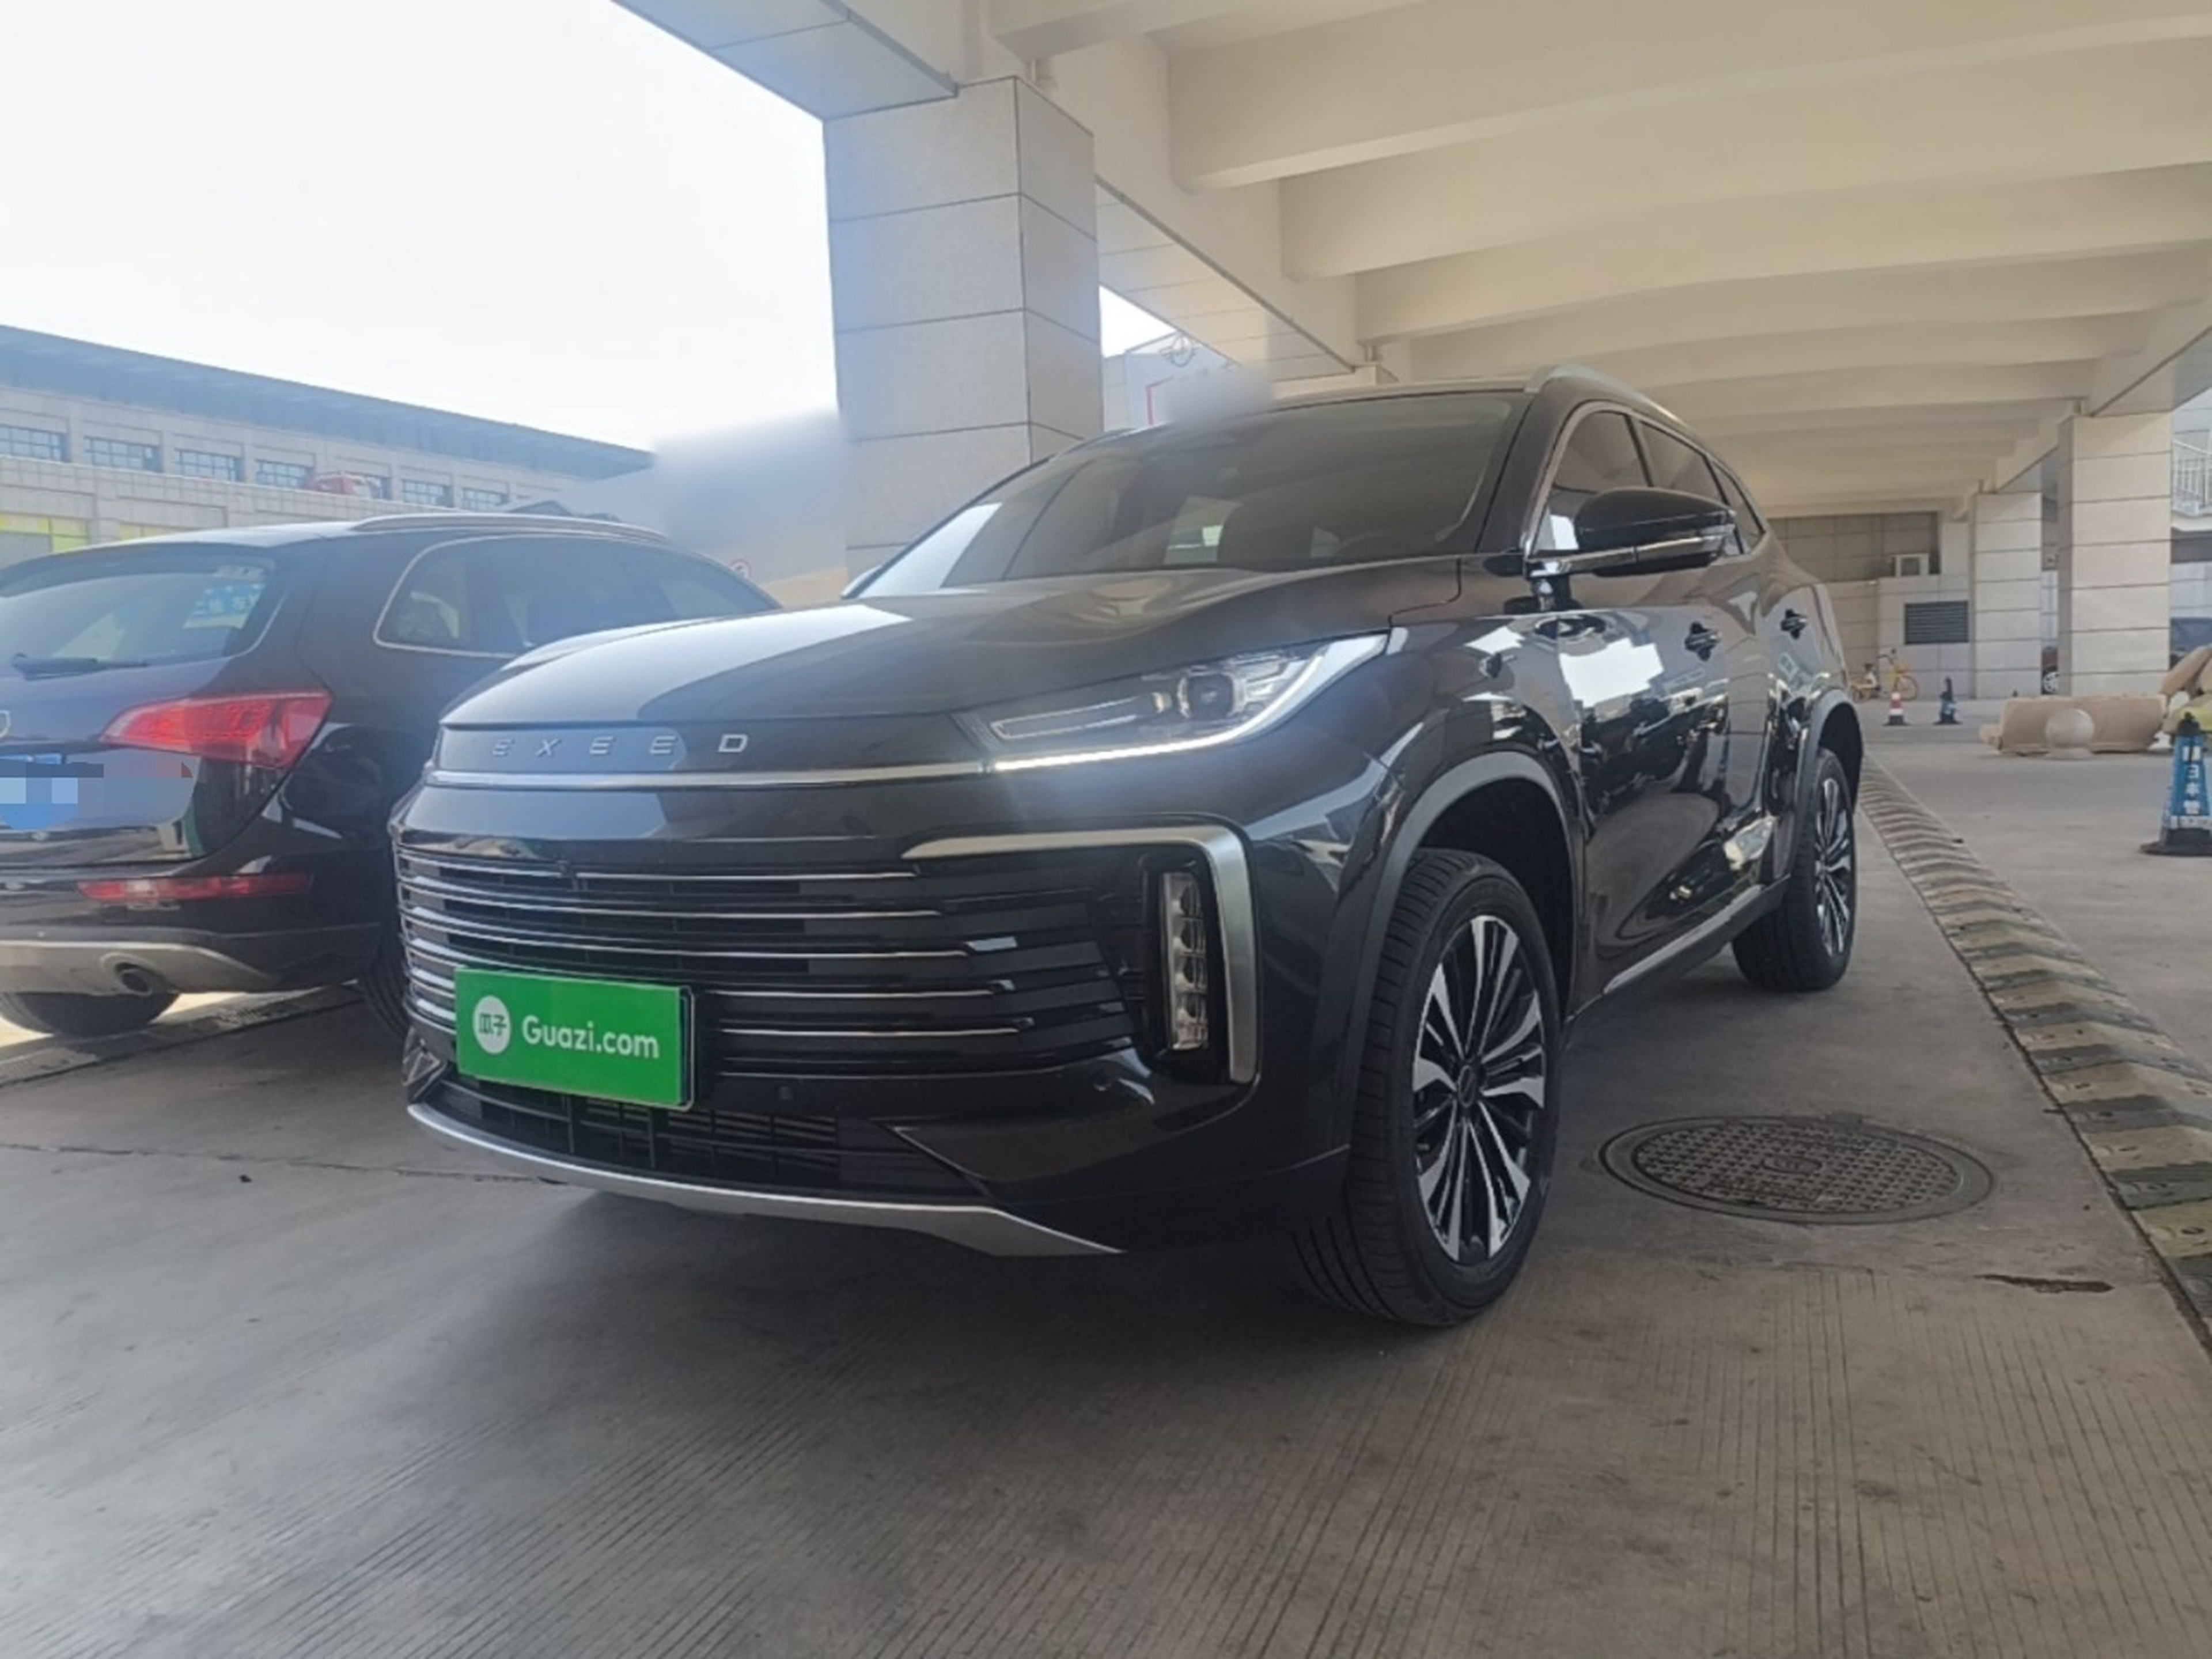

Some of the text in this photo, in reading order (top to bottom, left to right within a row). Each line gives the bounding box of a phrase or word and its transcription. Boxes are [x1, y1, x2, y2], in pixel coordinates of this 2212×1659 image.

[491, 733, 748, 756] EXEED
[478, 1012, 507, 1036] 瓜子
[522, 1014, 659, 1058] Guazi.com
